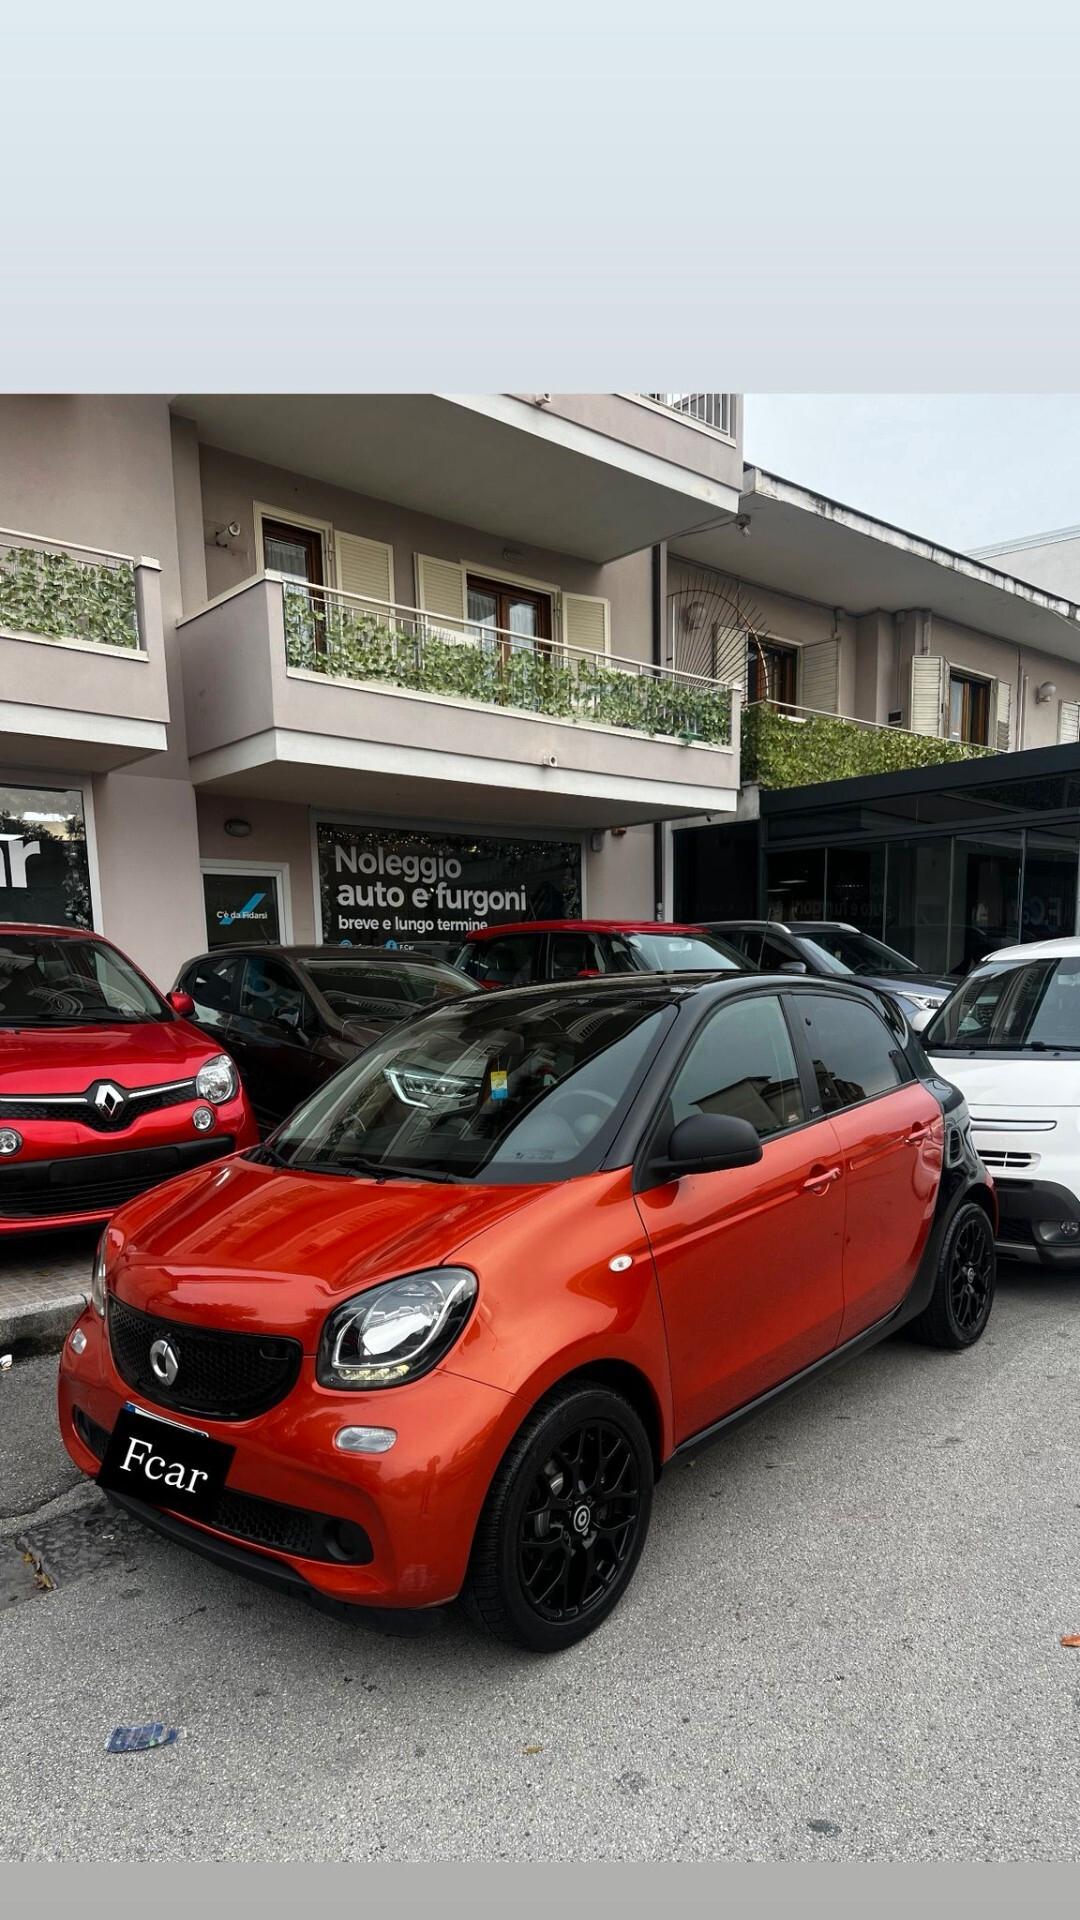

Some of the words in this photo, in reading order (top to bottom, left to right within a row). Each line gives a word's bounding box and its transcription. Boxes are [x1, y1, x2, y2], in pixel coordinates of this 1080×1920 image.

[0, 840, 41, 889] r
[335, 845, 462, 884] Noleggio
[230, 911, 241, 919] da
[242, 911, 268, 919] Fidarsi
[336, 881, 404, 907] auto
[412, 886, 429, 908] e
[436, 882, 527, 916] furgoni
[338, 915, 380, 931] breve
[382, 919, 391, 930] e
[395, 916, 434, 934] lungo
[437, 917, 488, 931] termine
